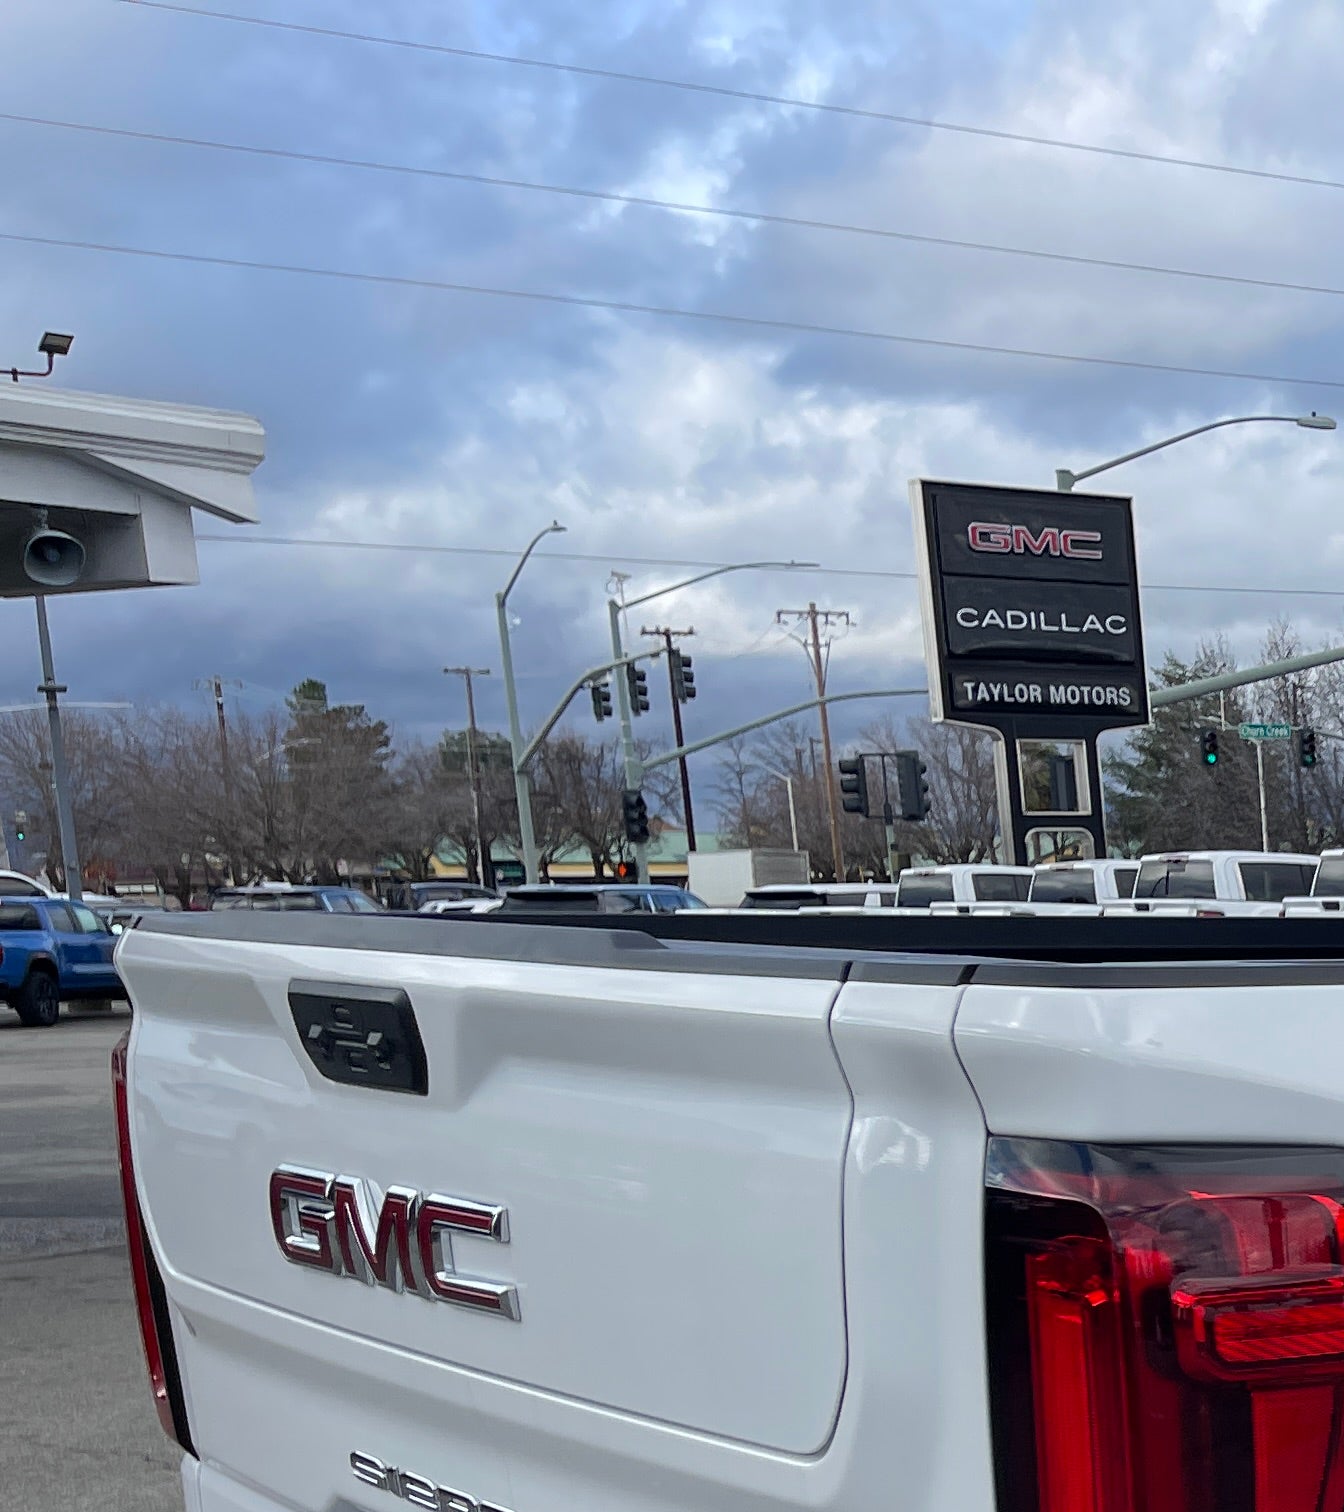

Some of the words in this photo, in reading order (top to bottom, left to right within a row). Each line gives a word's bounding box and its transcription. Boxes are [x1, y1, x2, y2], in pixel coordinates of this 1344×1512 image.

[967, 521, 1103, 559] GMC
[956, 607, 1128, 635] CADILLAC
[963, 681, 1043, 704] TAYLOR
[1049, 684, 1131, 706] MOTORS
[269, 1161, 522, 1323] GMC
